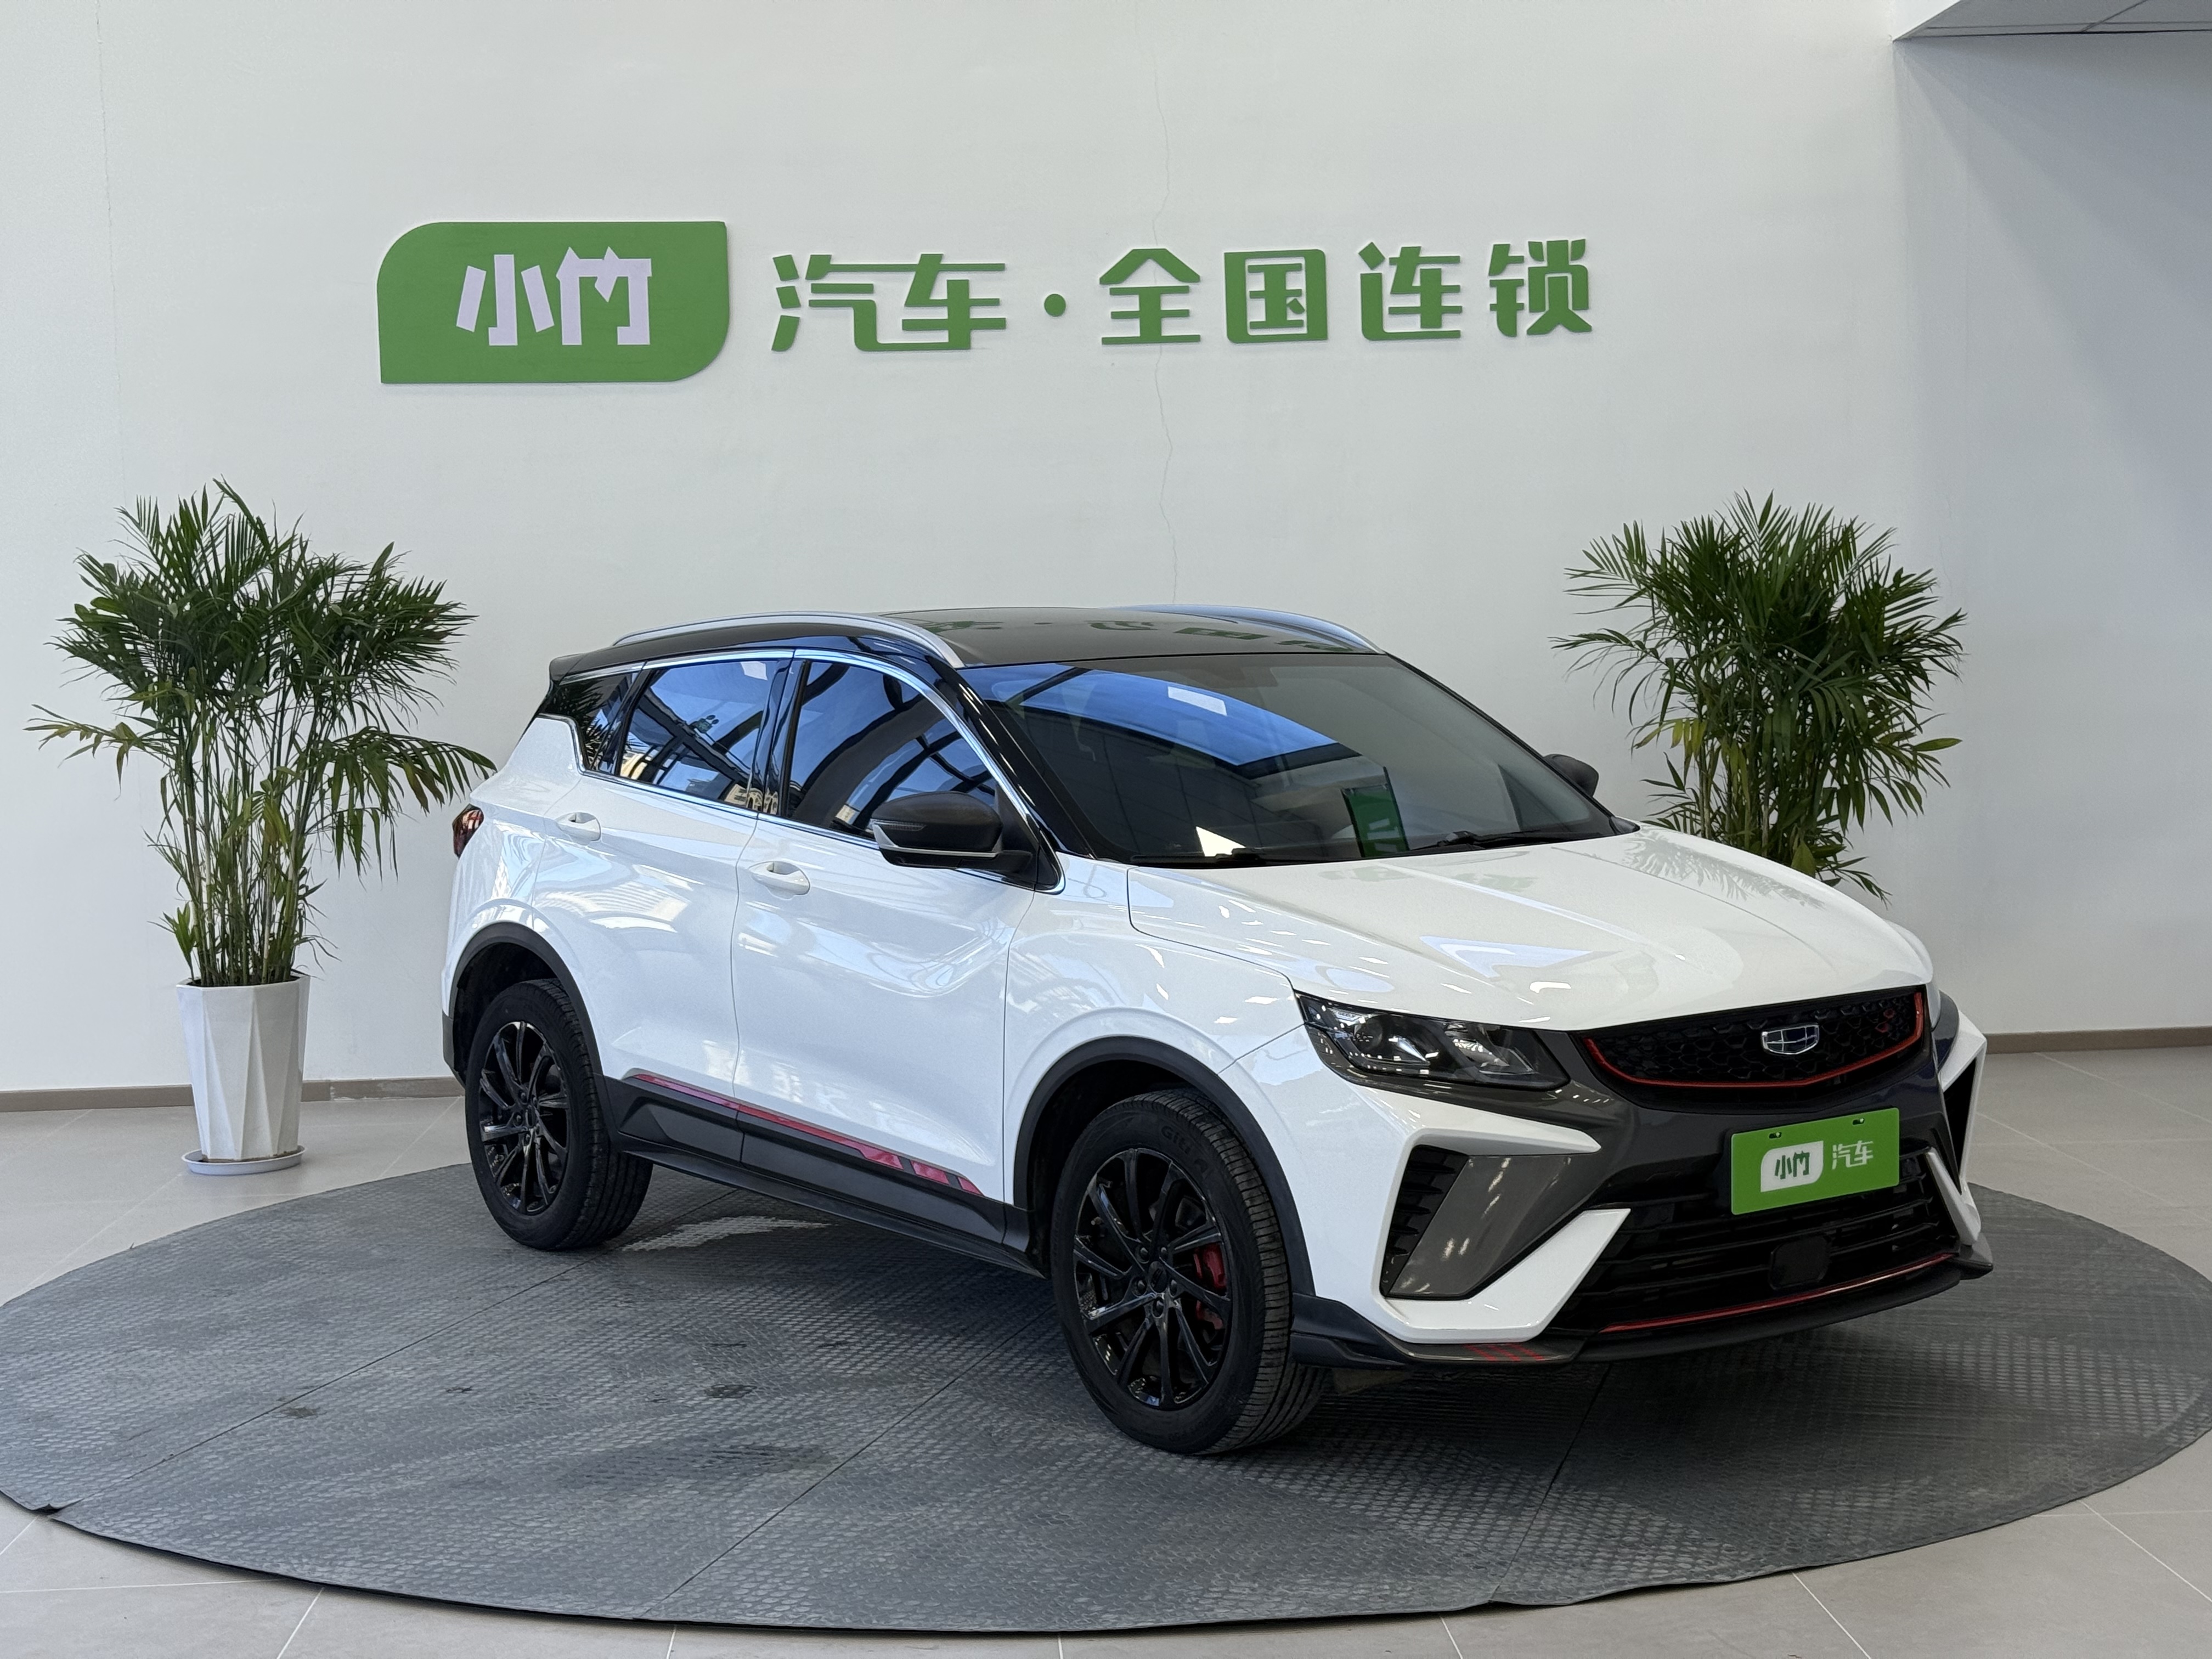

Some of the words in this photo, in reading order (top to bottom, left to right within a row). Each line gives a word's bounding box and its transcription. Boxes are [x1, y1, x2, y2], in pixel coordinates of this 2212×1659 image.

[455, 246, 652, 347] 小竹
[1774, 1150, 1810, 1180] 小竹
[1831, 1140, 1874, 1171] 汽车
